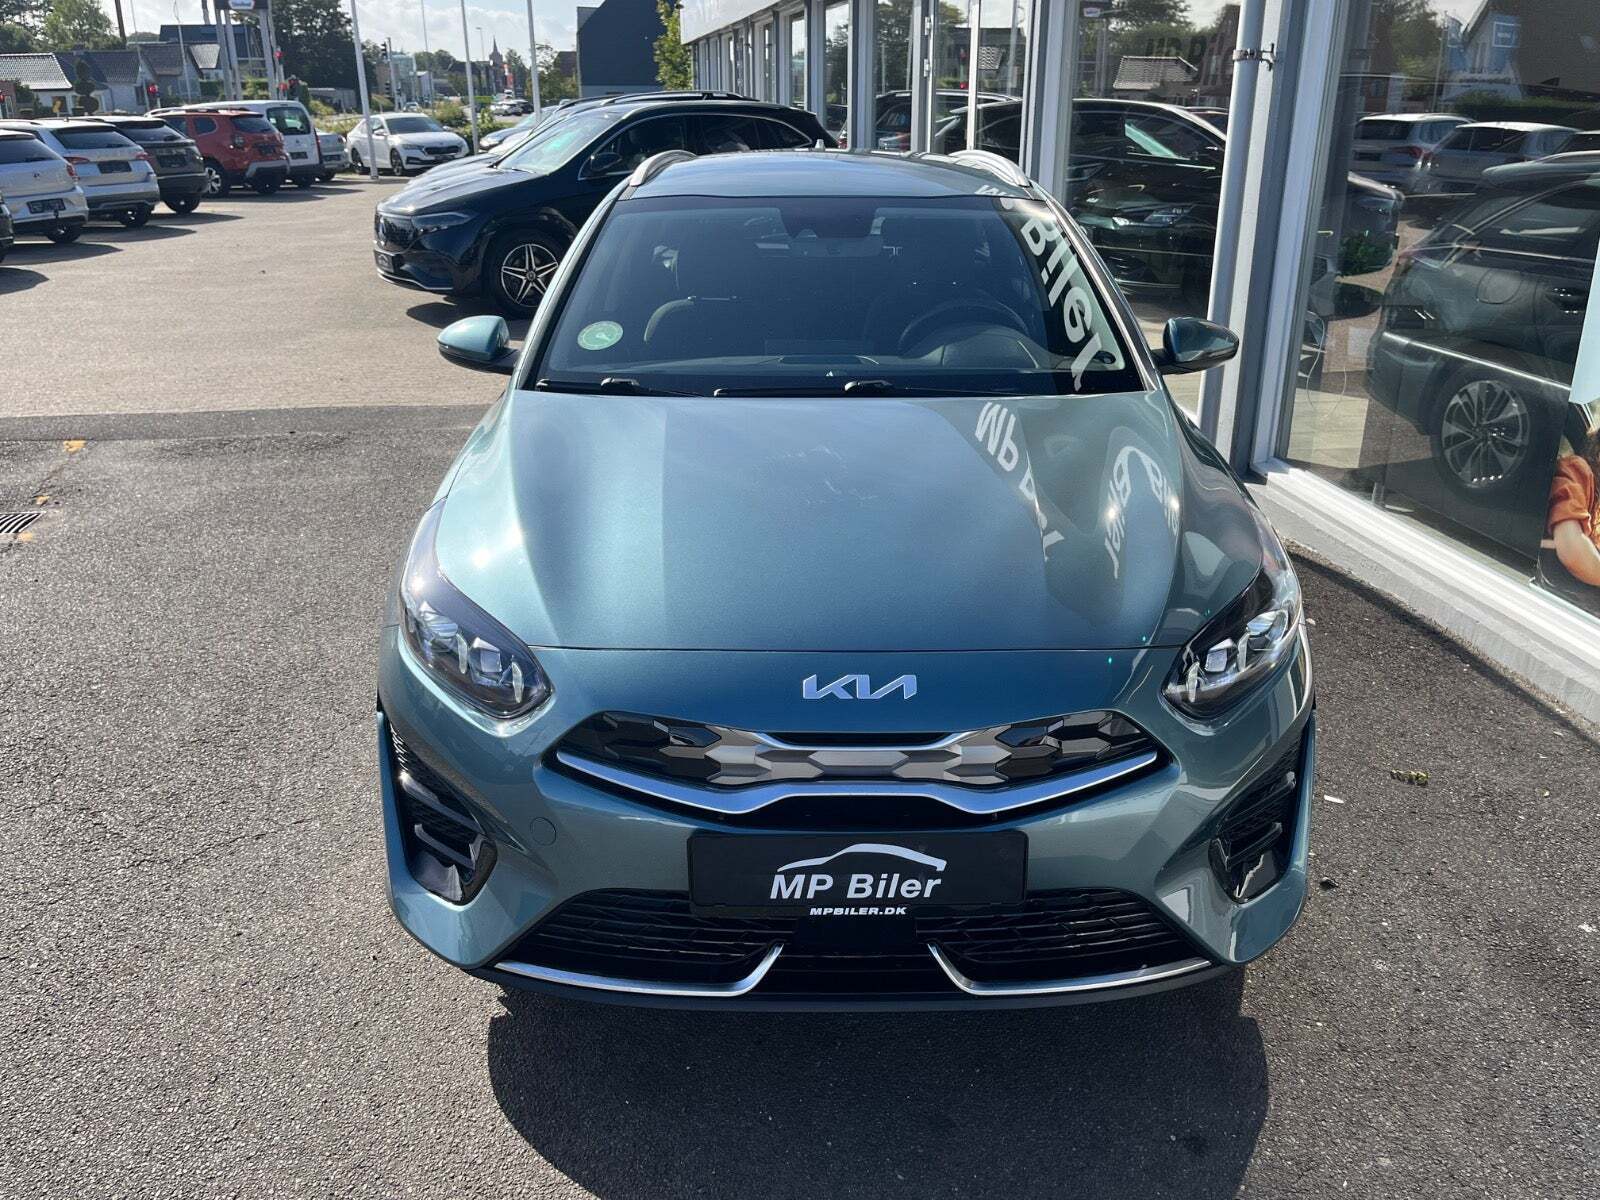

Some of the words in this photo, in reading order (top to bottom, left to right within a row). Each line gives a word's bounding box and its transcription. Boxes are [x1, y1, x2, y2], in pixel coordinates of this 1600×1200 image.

[802, 674, 917, 700] KIA
[770, 874, 834, 899] MP
[847, 873, 942, 899] Biler
[809, 906, 907, 916] MPBILER.DK
